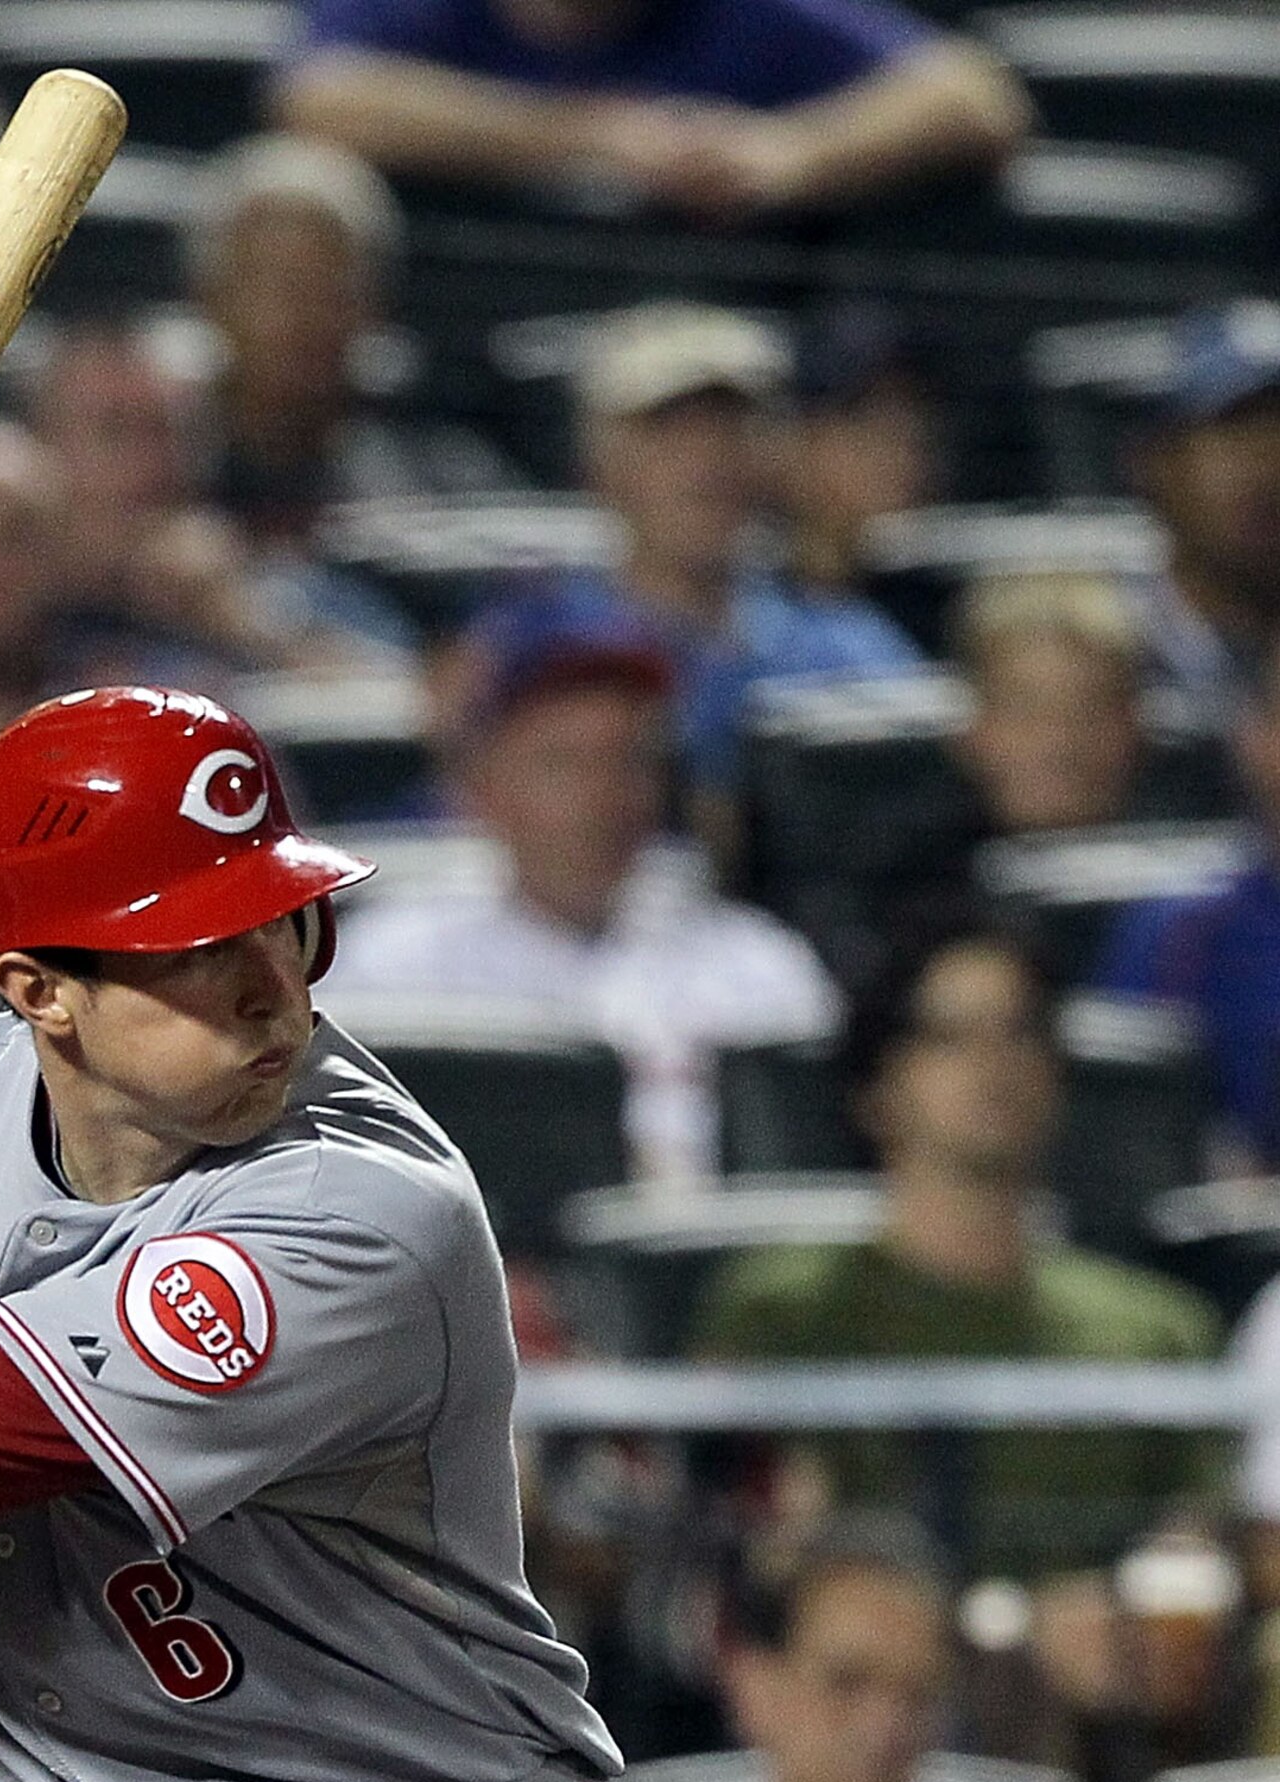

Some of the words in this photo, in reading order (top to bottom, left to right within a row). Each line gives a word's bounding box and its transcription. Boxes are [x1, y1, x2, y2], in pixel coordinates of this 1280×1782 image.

[179, 749, 268, 834] C
[154, 1264, 256, 1378] REDS
[104, 1559, 242, 1702] 6
